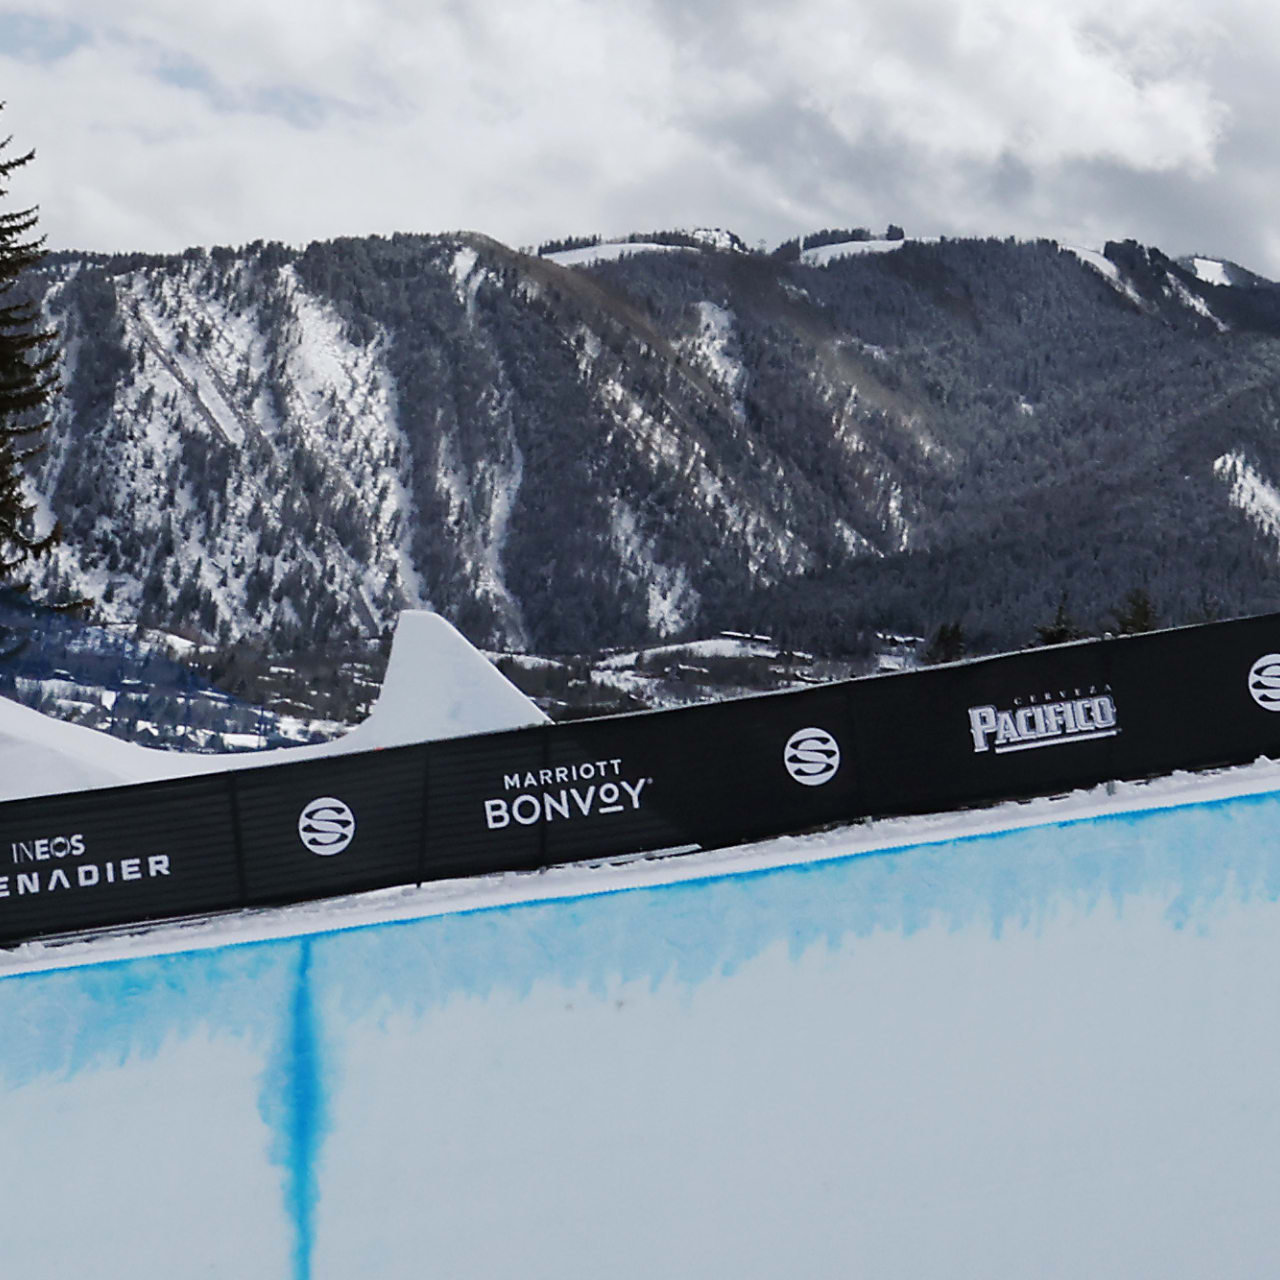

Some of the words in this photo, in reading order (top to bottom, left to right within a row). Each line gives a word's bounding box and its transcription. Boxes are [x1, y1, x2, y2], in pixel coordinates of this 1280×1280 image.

[1013, 683, 1113, 706] CERVEZA
[503, 759, 622, 790] MARRIOTT
[484, 777, 647, 829] BONVOY
[12, 834, 86, 864] INEOS
